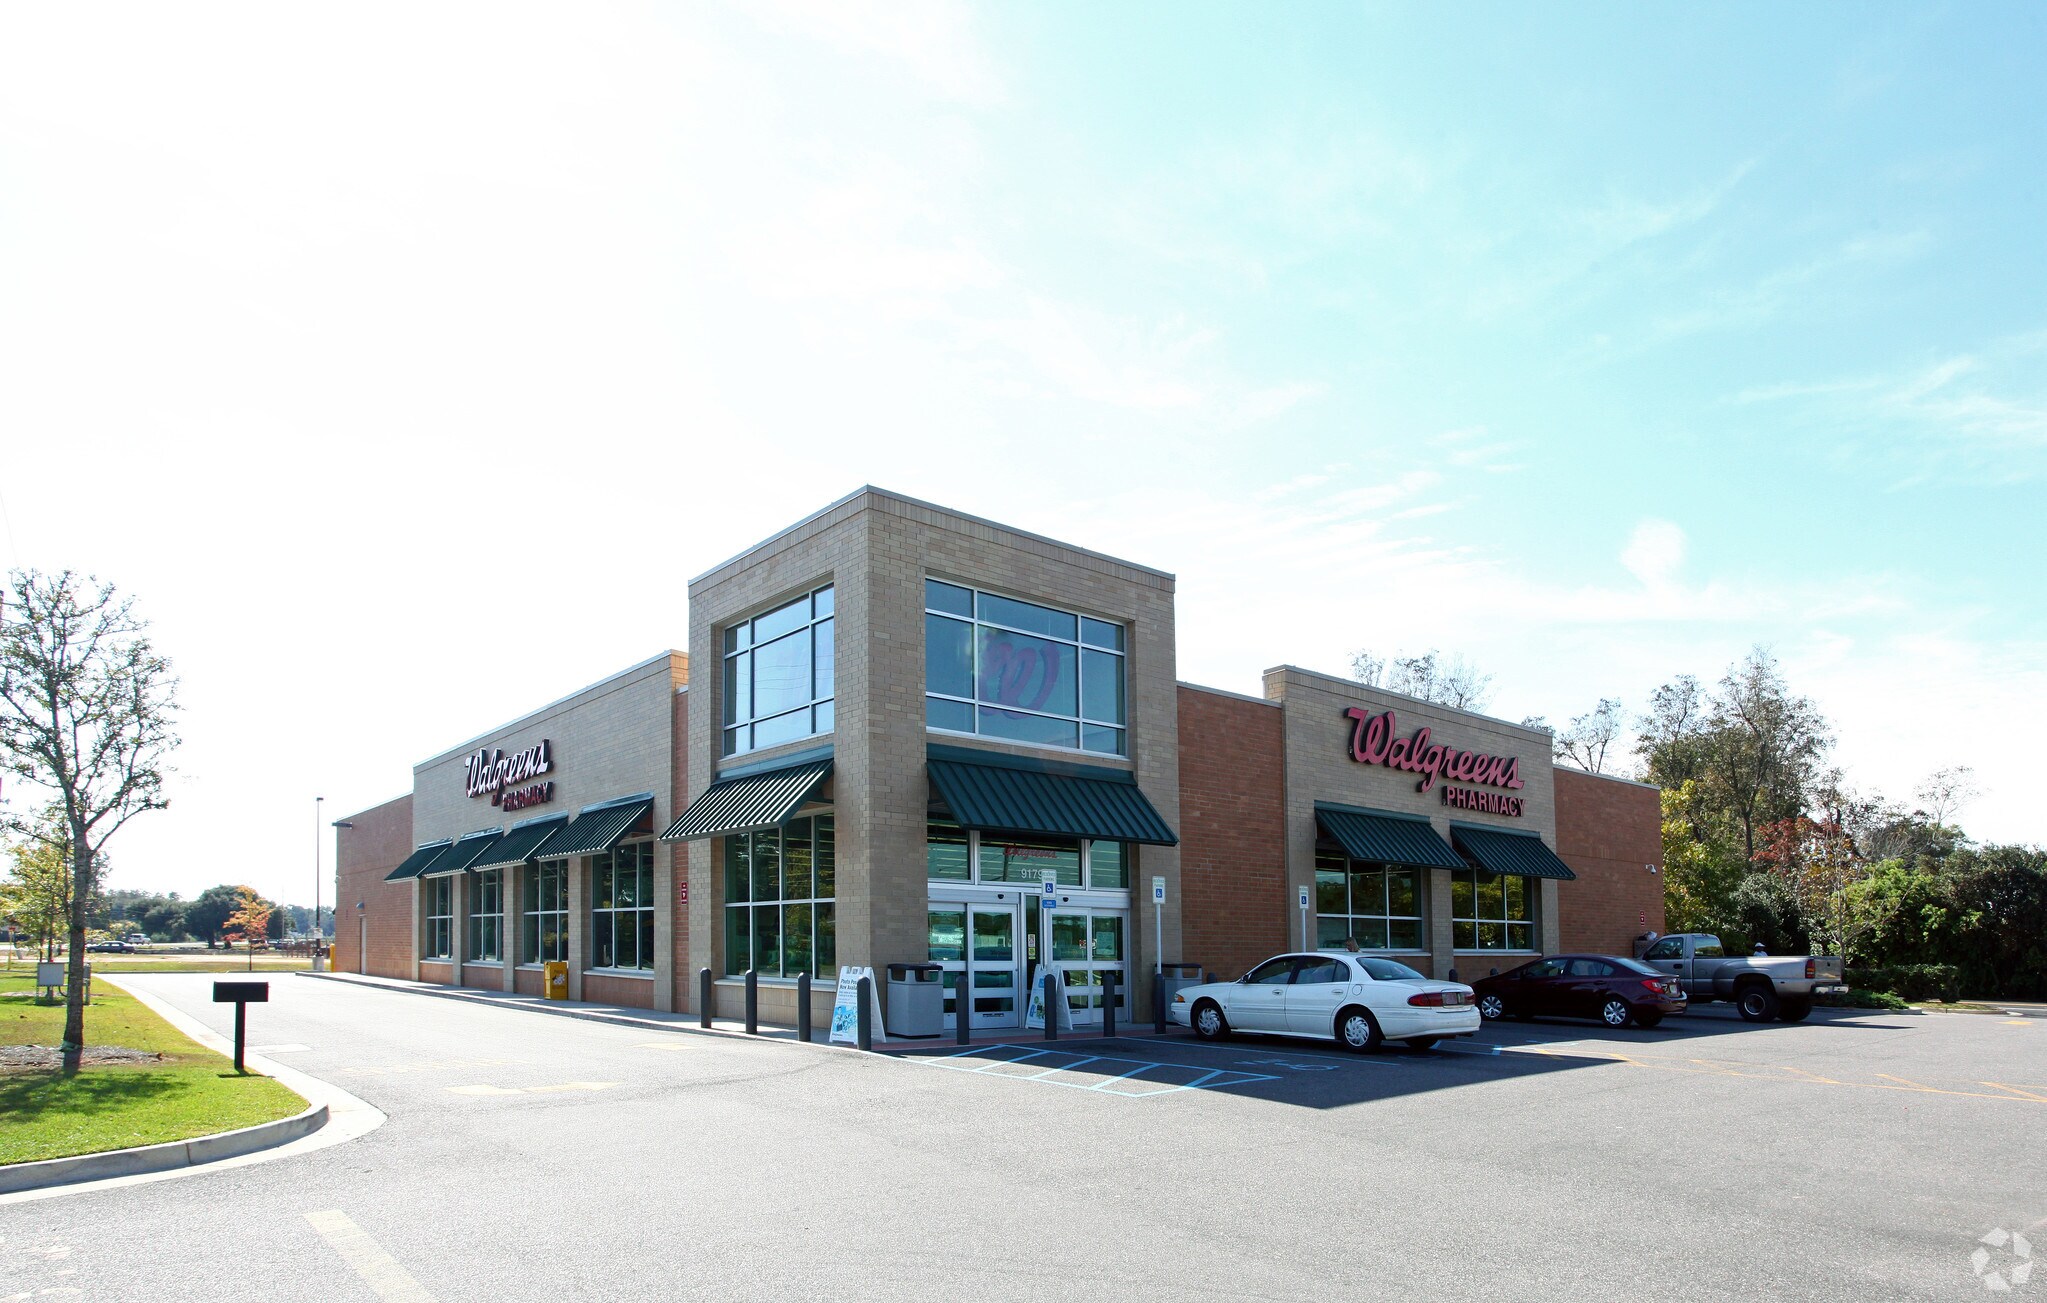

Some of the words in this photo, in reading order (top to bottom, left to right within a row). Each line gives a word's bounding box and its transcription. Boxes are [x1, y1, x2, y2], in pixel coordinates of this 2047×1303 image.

[465, 739, 551, 806] Walgreens
[1345, 707, 1525, 793] Walgreens
[502, 782, 553, 812] PHARMACY
[1444, 786, 1526, 817] PHARMACY
